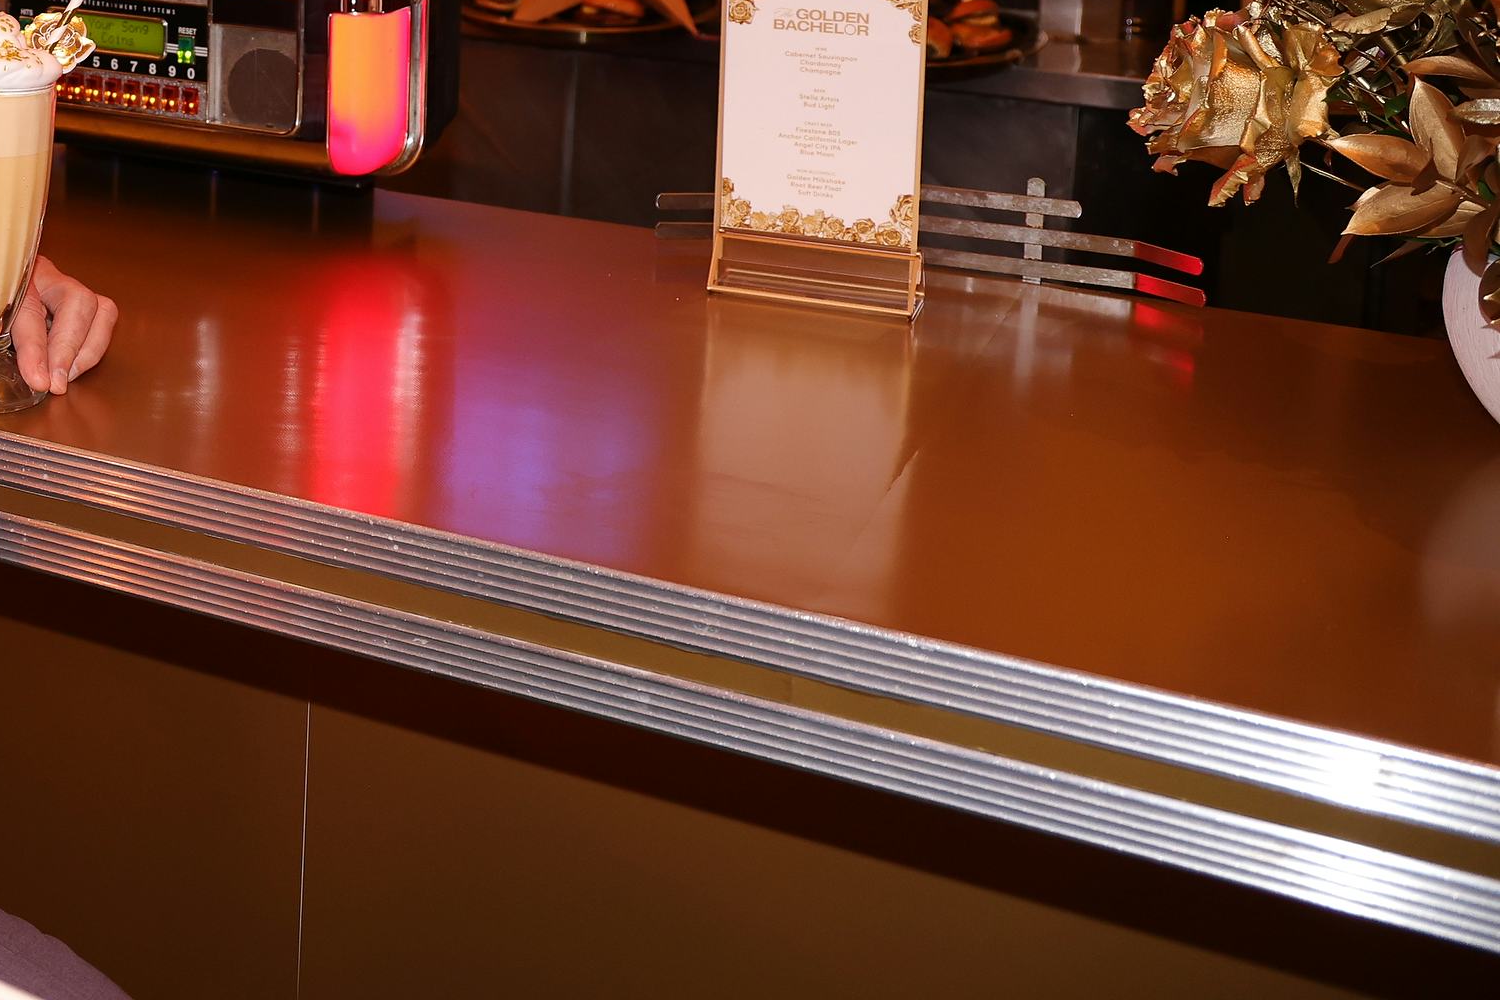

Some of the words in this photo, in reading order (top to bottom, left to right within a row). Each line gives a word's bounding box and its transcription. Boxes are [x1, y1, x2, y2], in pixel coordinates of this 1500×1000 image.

[796, 8, 869, 24] GOLDEN
[121, 16, 150, 35] Song
[177, 26, 198, 36] RESET
[773, 18, 869, 36] BACHELOR
[785, 50, 816, 59] Cabernet
[92, 56, 101, 68] 5
[110, 58, 119, 71] 6
[129, 60, 139, 73] 7
[148, 62, 157, 76] 8
[167, 65, 177, 78] 9
[186, 68, 196, 80] 0
[799, 58, 842, 69] Chardonnay
[799, 66, 842, 76] Champagne
[818, 102, 835, 111] Light
